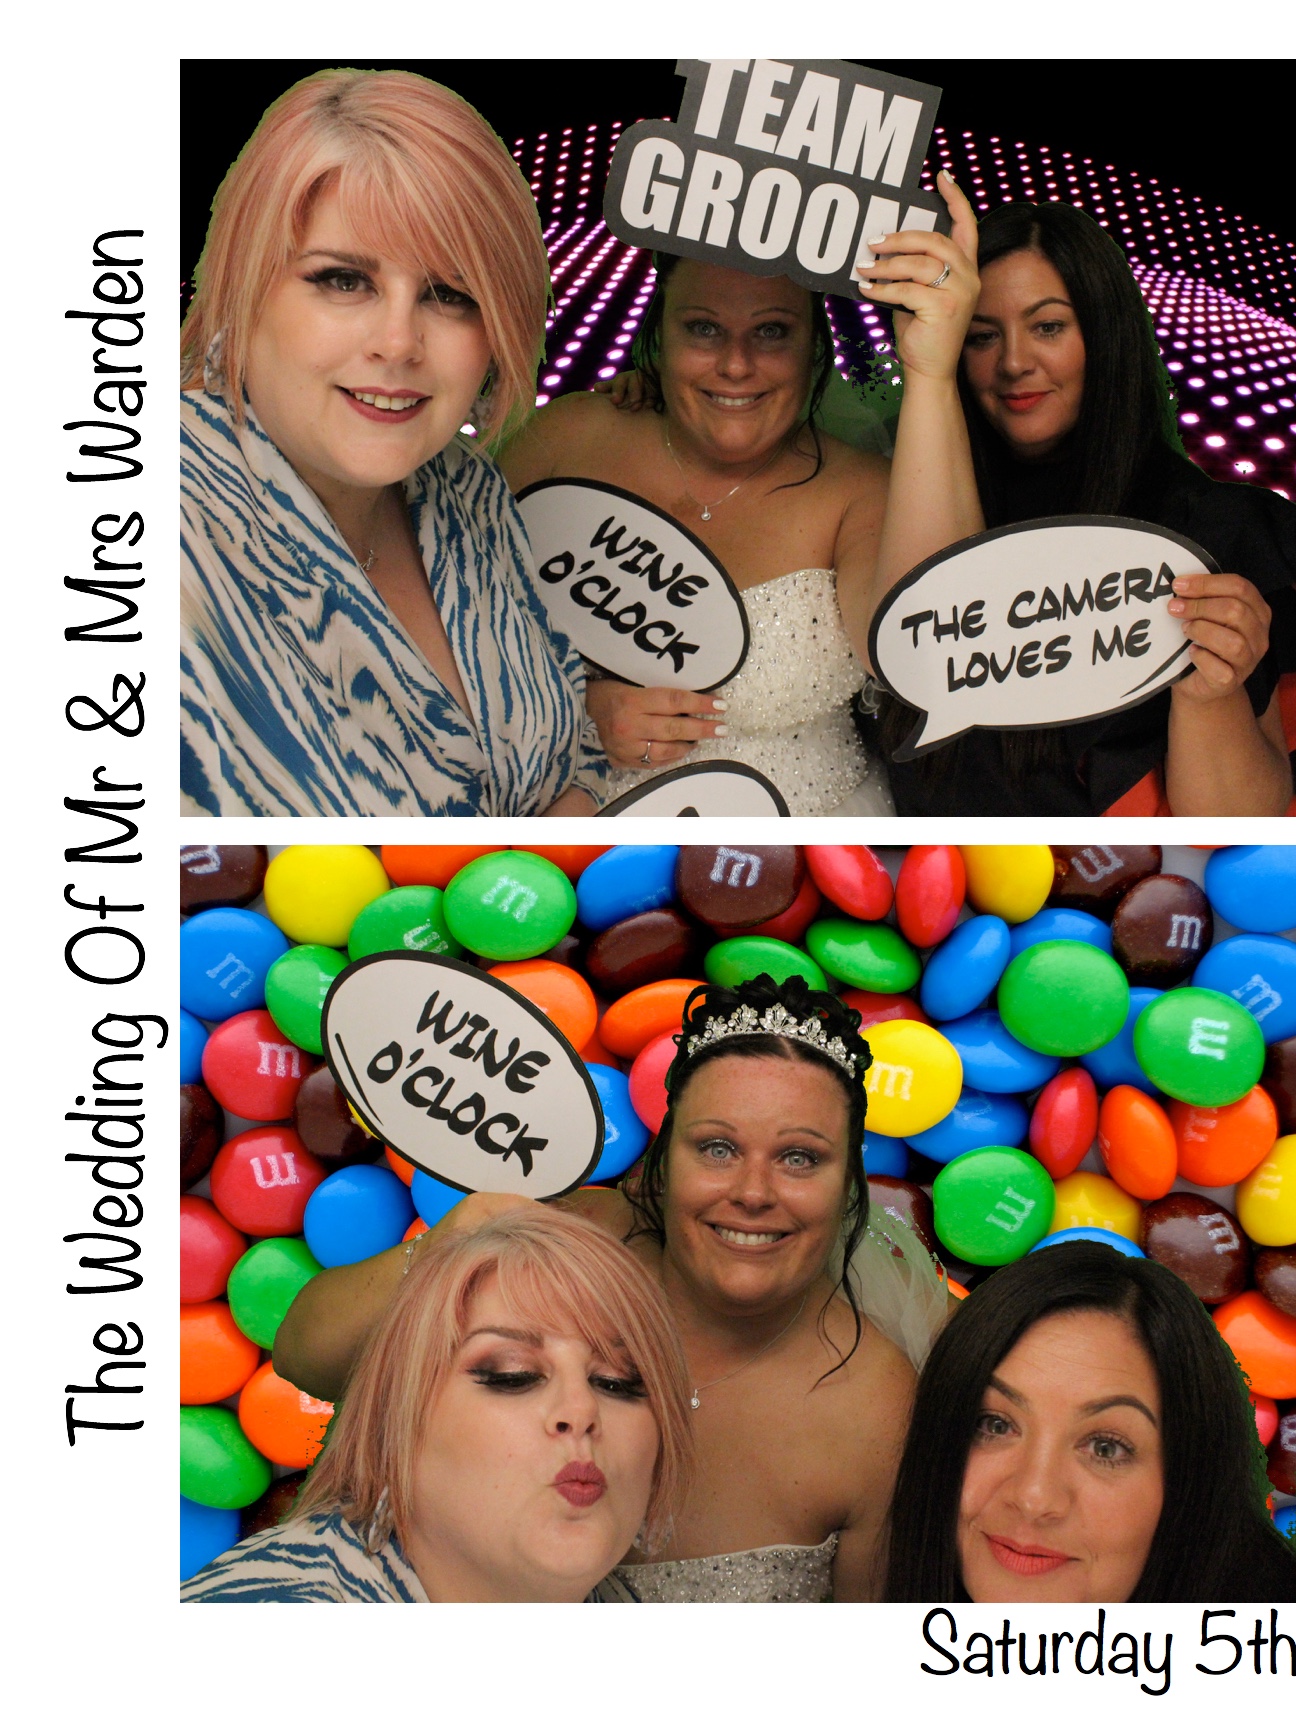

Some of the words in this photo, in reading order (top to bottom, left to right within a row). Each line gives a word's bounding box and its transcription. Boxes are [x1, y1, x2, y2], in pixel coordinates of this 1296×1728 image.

[693, 59, 924, 188] TEAM
[538, 550, 700, 674] O'CLOCK
[590, 515, 710, 608] WINE
[900, 599, 987, 649] THE
[1007, 559, 1176, 629] CAMERA
[947, 634, 1072, 693] LOVES
[1092, 619, 1152, 666] ME
[416, 990, 551, 1094] WINE
[366, 1041, 549, 1177] O'CLOCK
